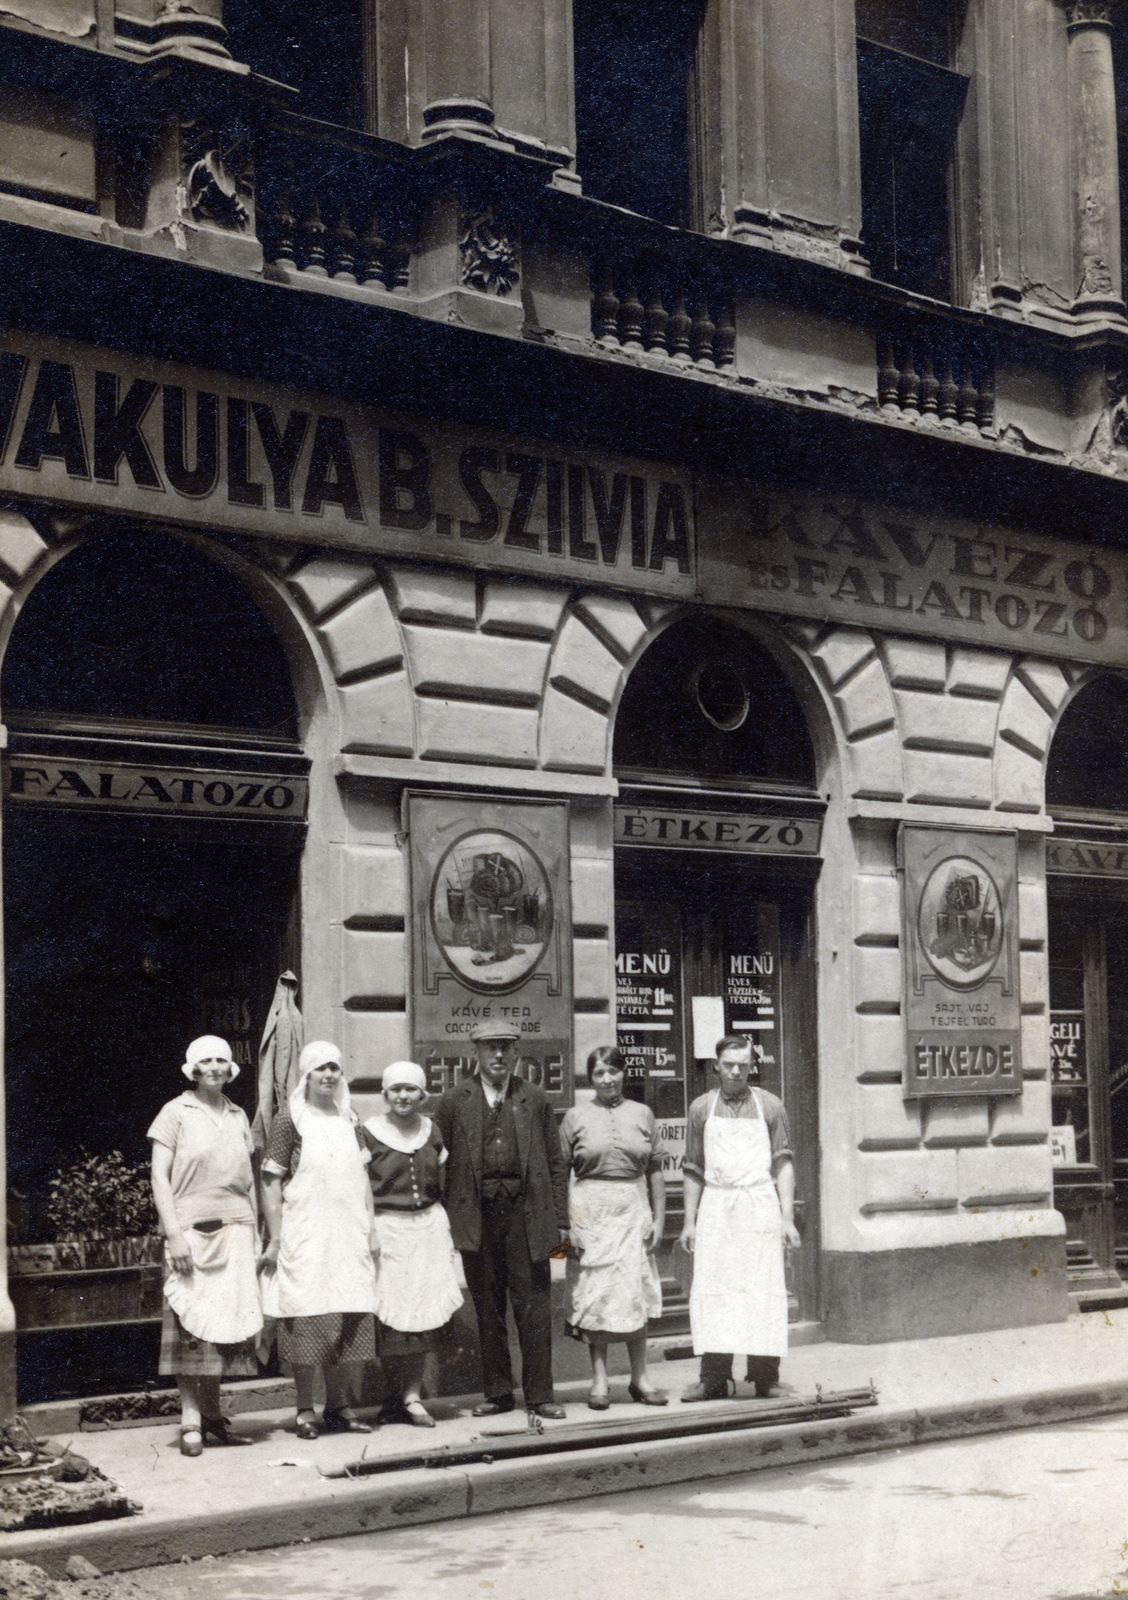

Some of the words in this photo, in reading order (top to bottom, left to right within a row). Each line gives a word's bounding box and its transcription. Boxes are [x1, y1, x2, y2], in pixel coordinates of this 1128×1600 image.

[459, 447, 695, 577] SZILVIA
[9, 766, 294, 810] FALATOZÓ
[730, 951, 774, 975] MENÜ
[727, 977, 751, 987] LEVES
[500, 1006, 531, 1018] TEA
[968, 1003, 989, 1013] VAJ
[929, 1016, 969, 1026] TEJFEL
[971, 1011, 997, 1026] TURÓ
[625, 1056, 646, 1066] SZTA
[914, 1036, 1014, 1080] ÉTKEZDE
[659, 1123, 687, 1141] ÖRET
